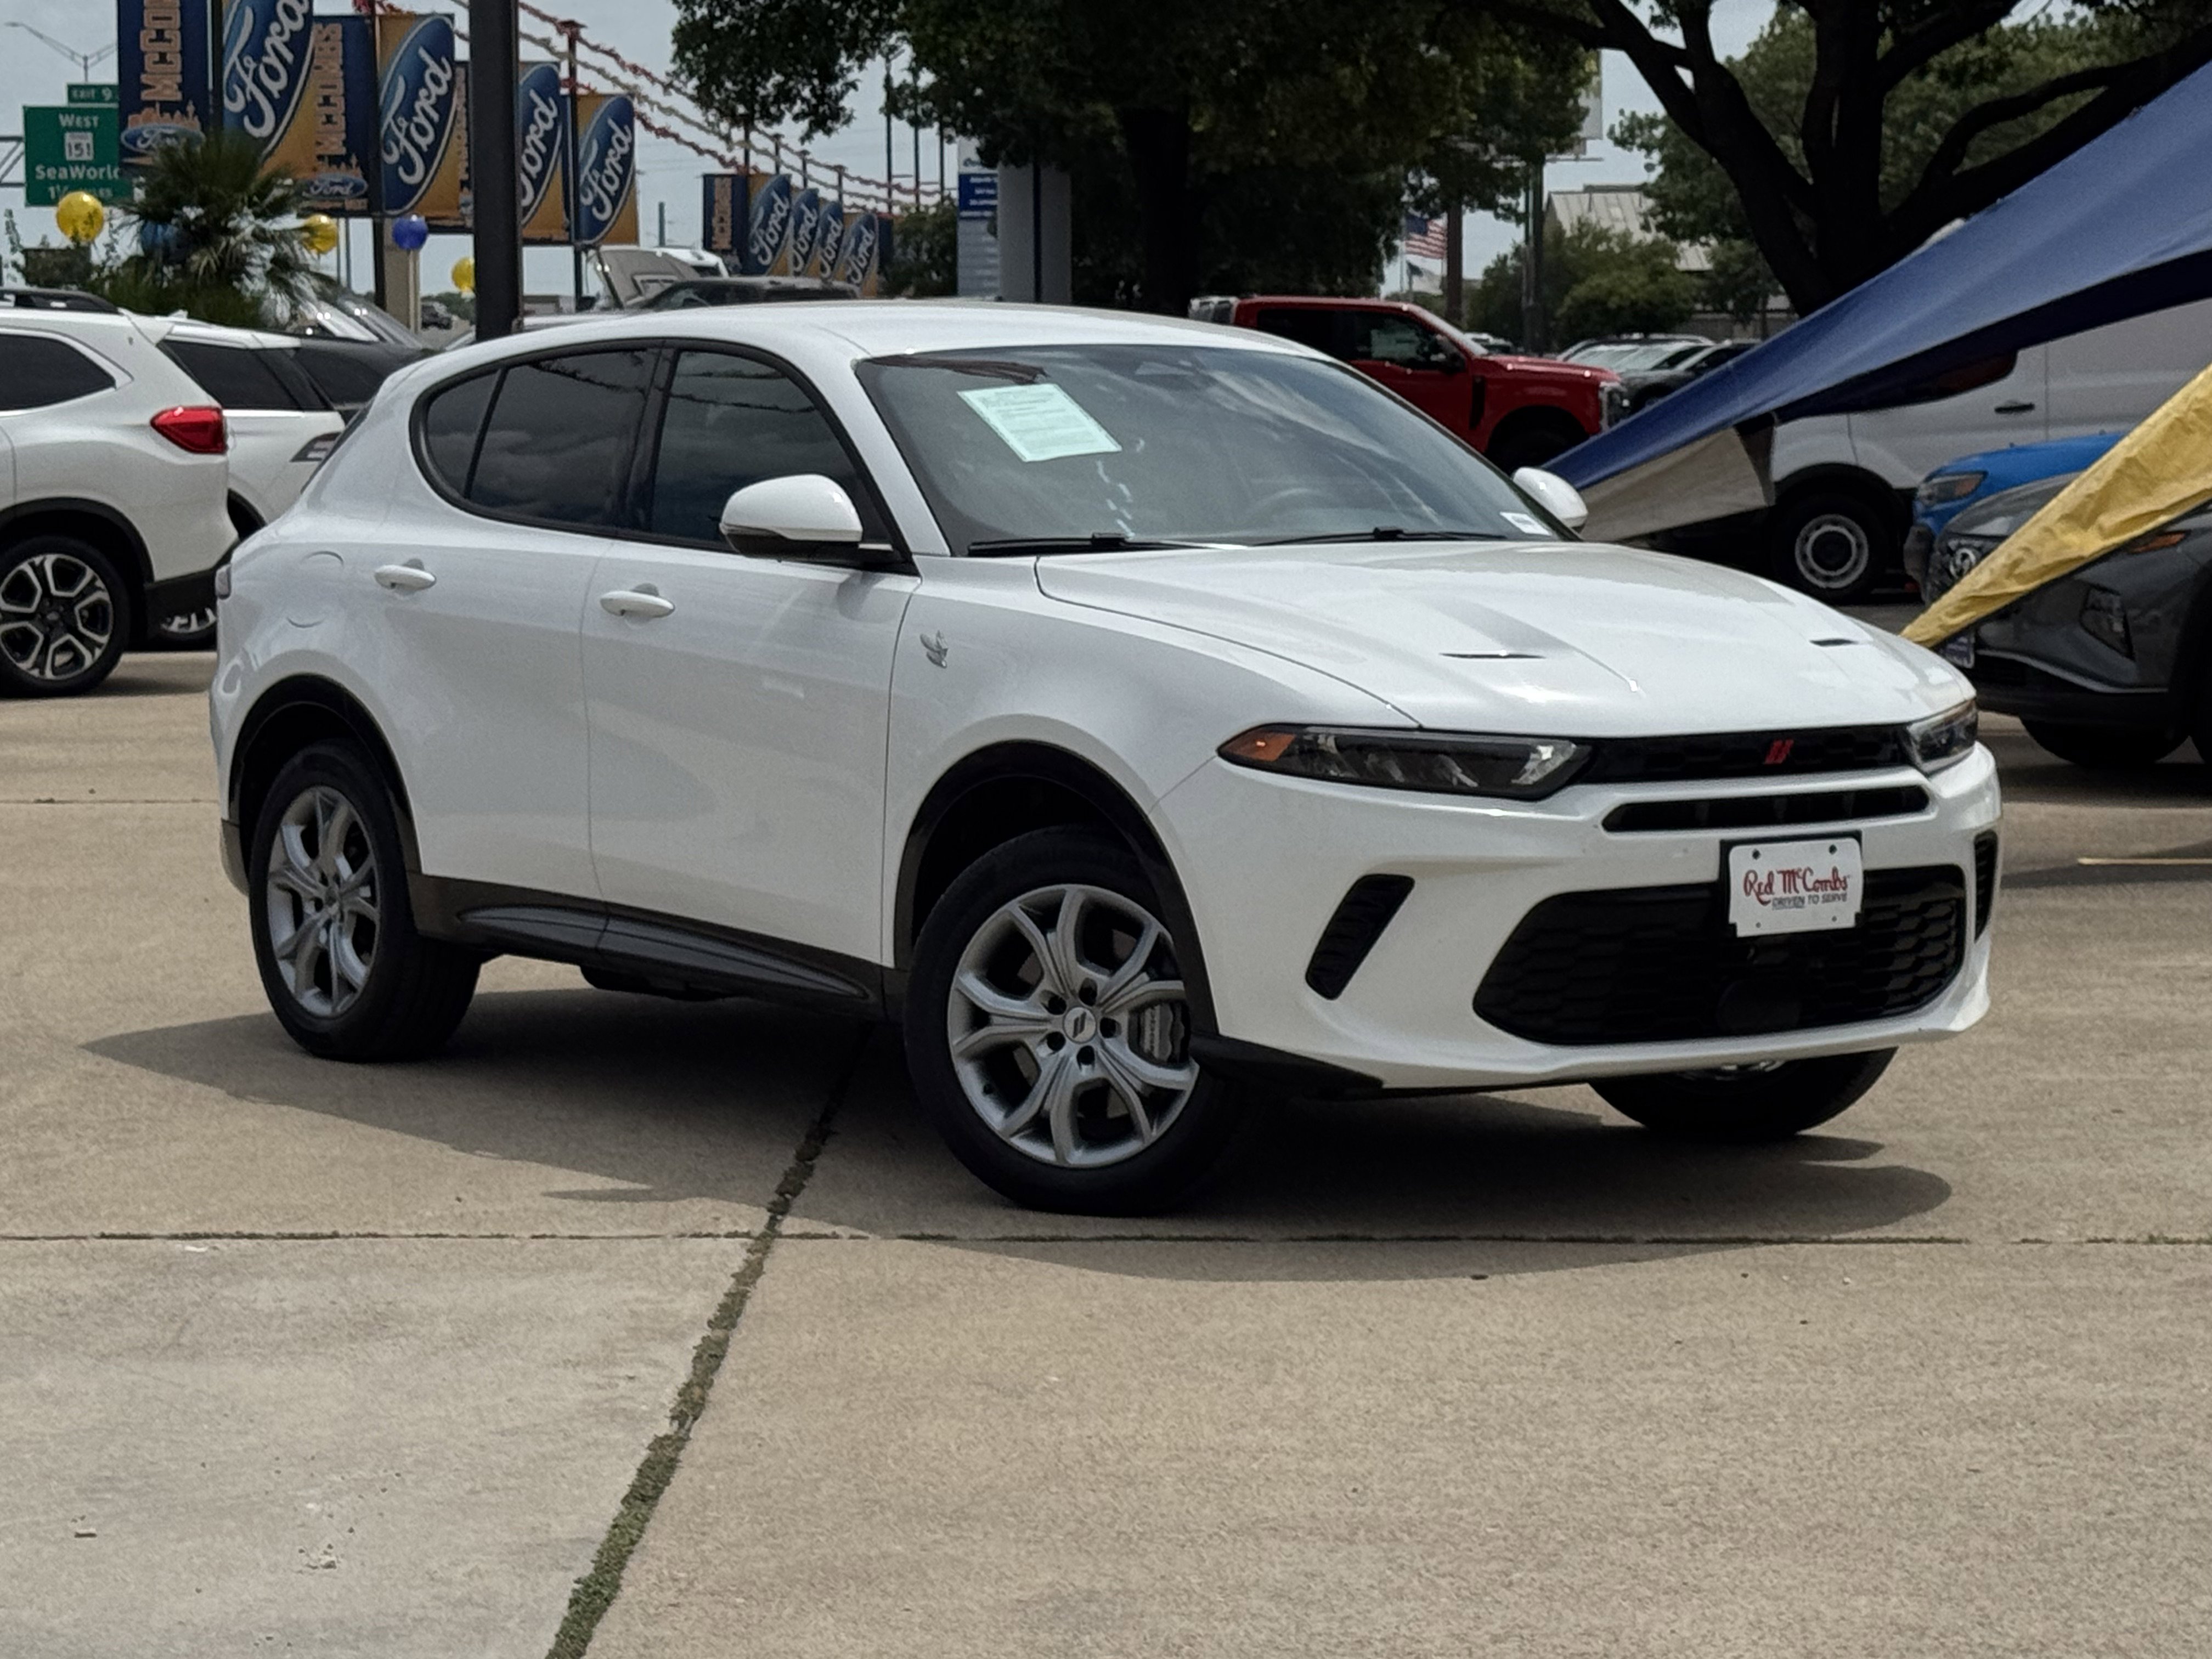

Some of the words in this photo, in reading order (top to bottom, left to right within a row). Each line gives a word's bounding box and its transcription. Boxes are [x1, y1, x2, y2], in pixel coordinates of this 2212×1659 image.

[140, 0, 182, 101] MCCO
[224, 0, 309, 137] Ford
[67, 142, 91, 157] 151
[382, 46, 453, 184] Ford
[579, 118, 632, 222] Ford
[749, 190, 790, 266] Ford
[1743, 869, 1775, 906] Red
[1776, 866, 1848, 894] McCombs
[1772, 895, 1805, 909] DRIVEN
[1808, 894, 1820, 905] TO
[1822, 892, 1847, 904] SERVE
